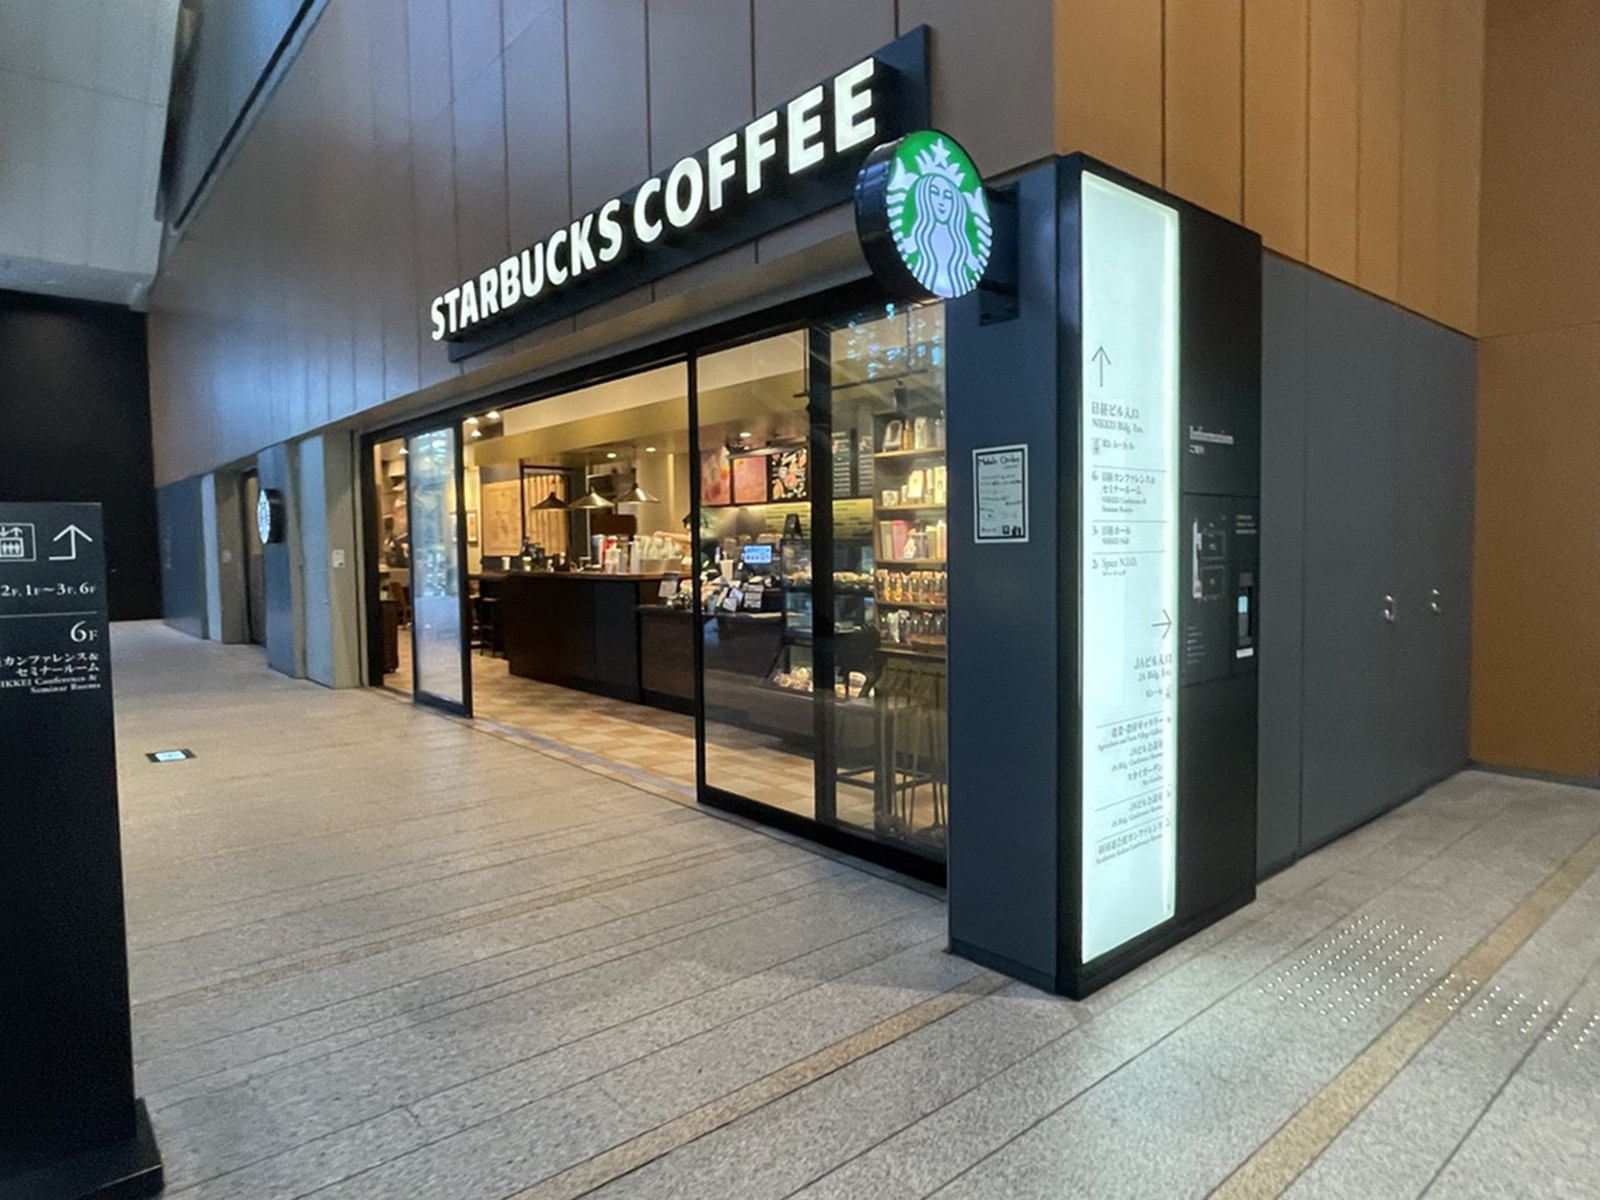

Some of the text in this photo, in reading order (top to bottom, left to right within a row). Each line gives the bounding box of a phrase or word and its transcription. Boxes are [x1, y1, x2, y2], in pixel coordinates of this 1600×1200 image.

[431, 57, 876, 342] STARBUCKS COFFEE
[69, 620, 99, 643] 6F
[0, 652, 99, 668] カンファレンス&
[16, 662, 100, 678] セミナールーム
[0, 679, 32, 689] IKKEI
